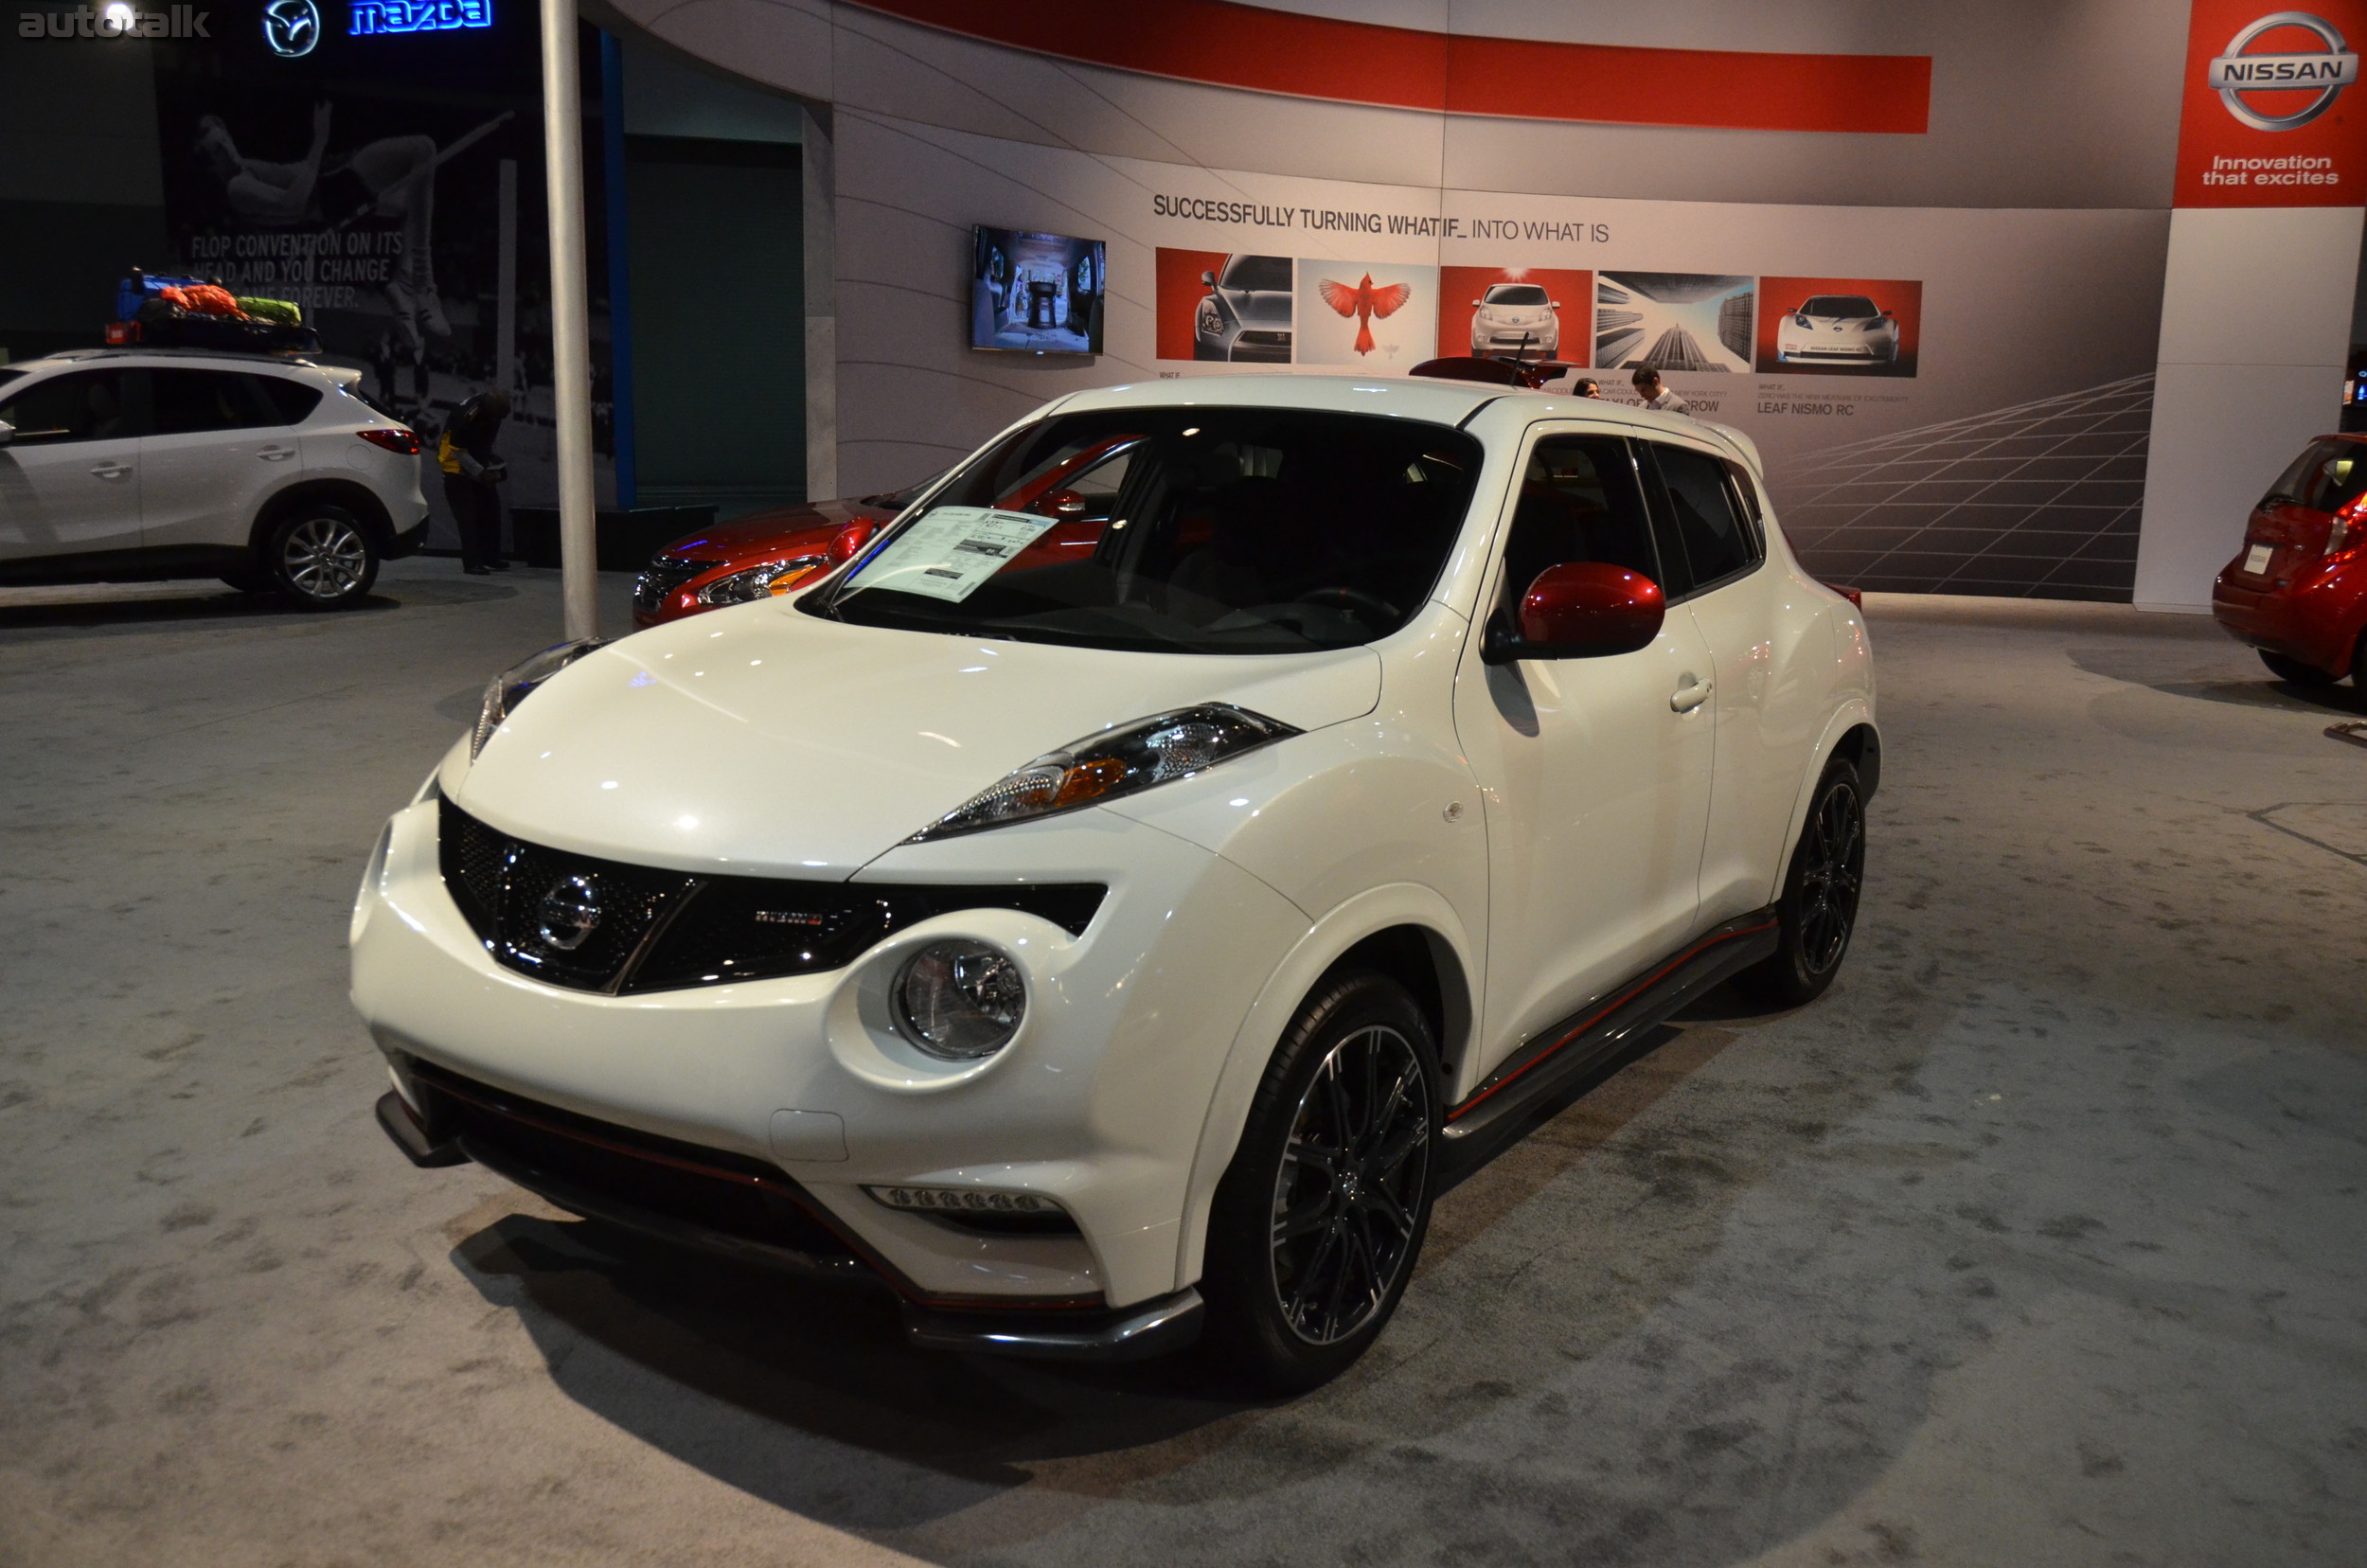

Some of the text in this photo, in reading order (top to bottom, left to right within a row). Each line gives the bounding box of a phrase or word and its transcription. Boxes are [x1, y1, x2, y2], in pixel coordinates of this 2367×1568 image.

[347, 0, 491, 35] mazda
[2224, 61, 2342, 81] NISSAN
[2213, 155, 2332, 170] Innovation
[2202, 170, 2340, 186] that excites
[1153, 193, 1295, 228] SUCCESSFULLY
[1300, 208, 1382, 235] TURNING
[1471, 220, 1520, 241] INTO
[1523, 222, 1585, 242] WHAT
[1591, 223, 1610, 243] IS
[191, 230, 402, 258] FLOP CONVENTION ON ITS
[240, 260, 276, 283] AND
[281, 259, 313, 283] YOU
[320, 258, 391, 282] CHANGE
[1757, 401, 1855, 417] LEAF NISMO RC
